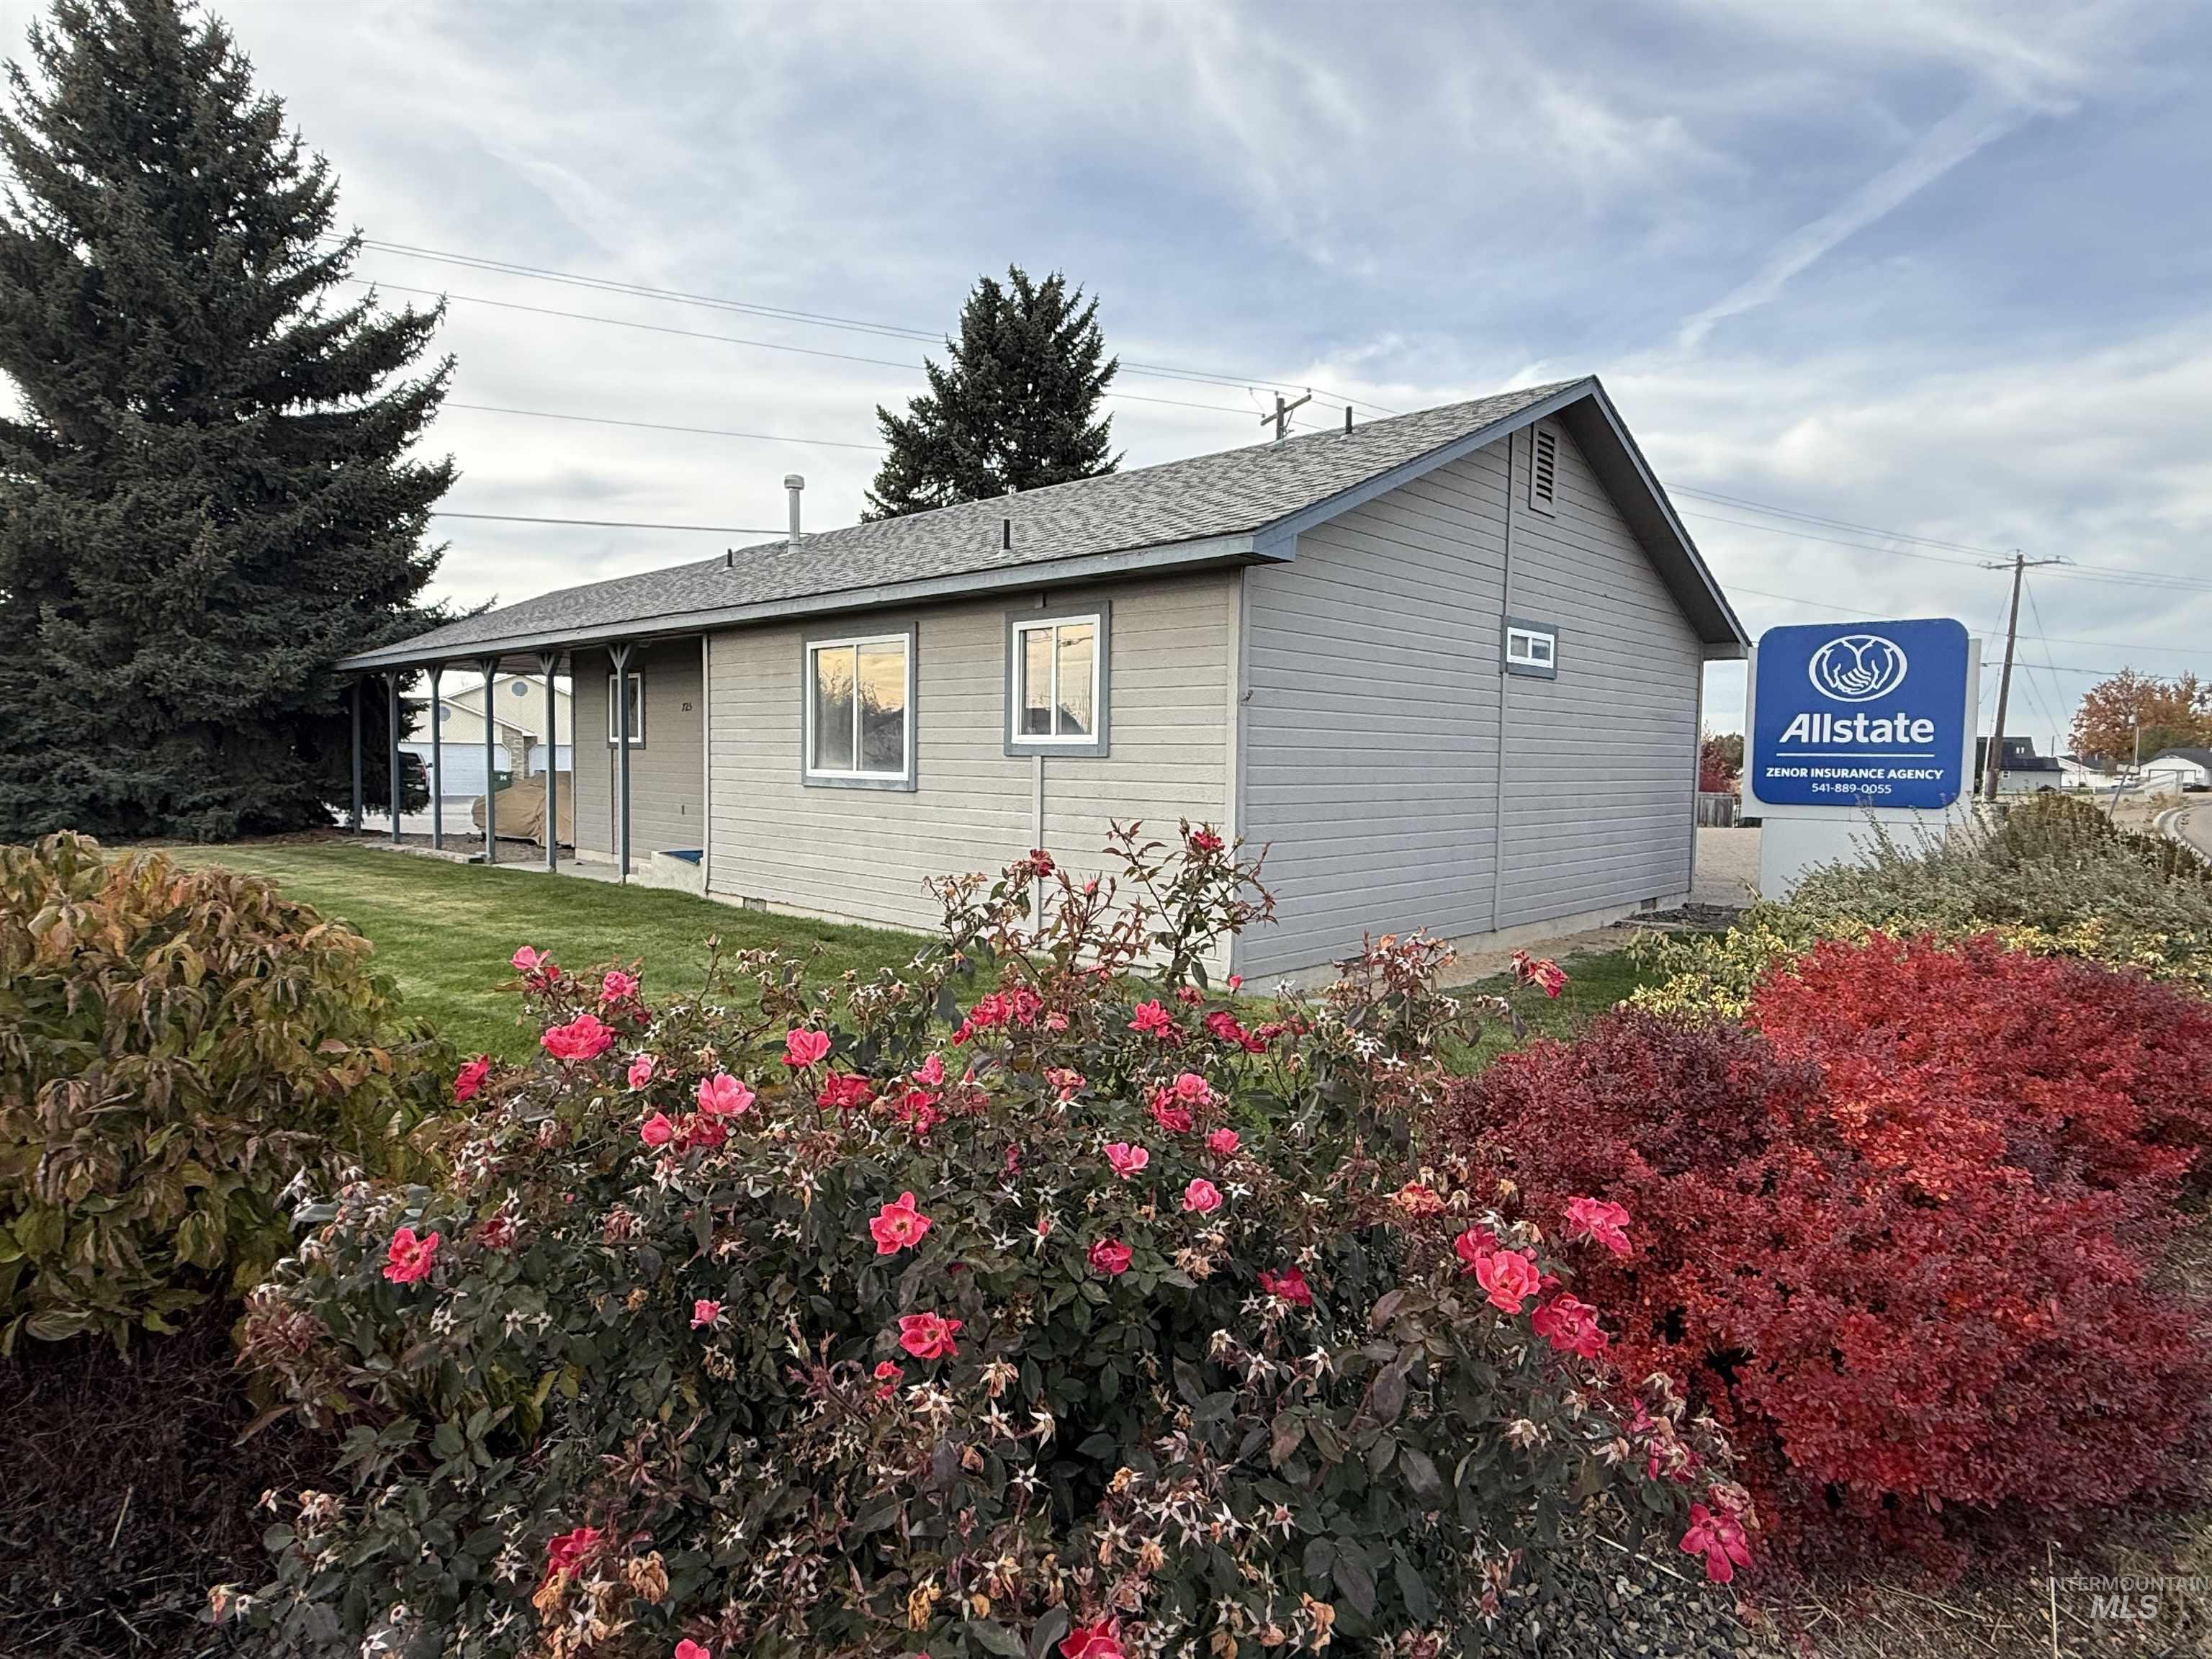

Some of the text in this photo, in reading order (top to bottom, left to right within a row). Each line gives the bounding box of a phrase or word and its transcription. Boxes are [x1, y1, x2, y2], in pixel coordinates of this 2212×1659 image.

[1779, 713, 1936, 743] Allstate
[1766, 768, 1943, 780] ZENOR INSURANCE AGENCY
[1812, 783, 1892, 794] 541-889-0055
